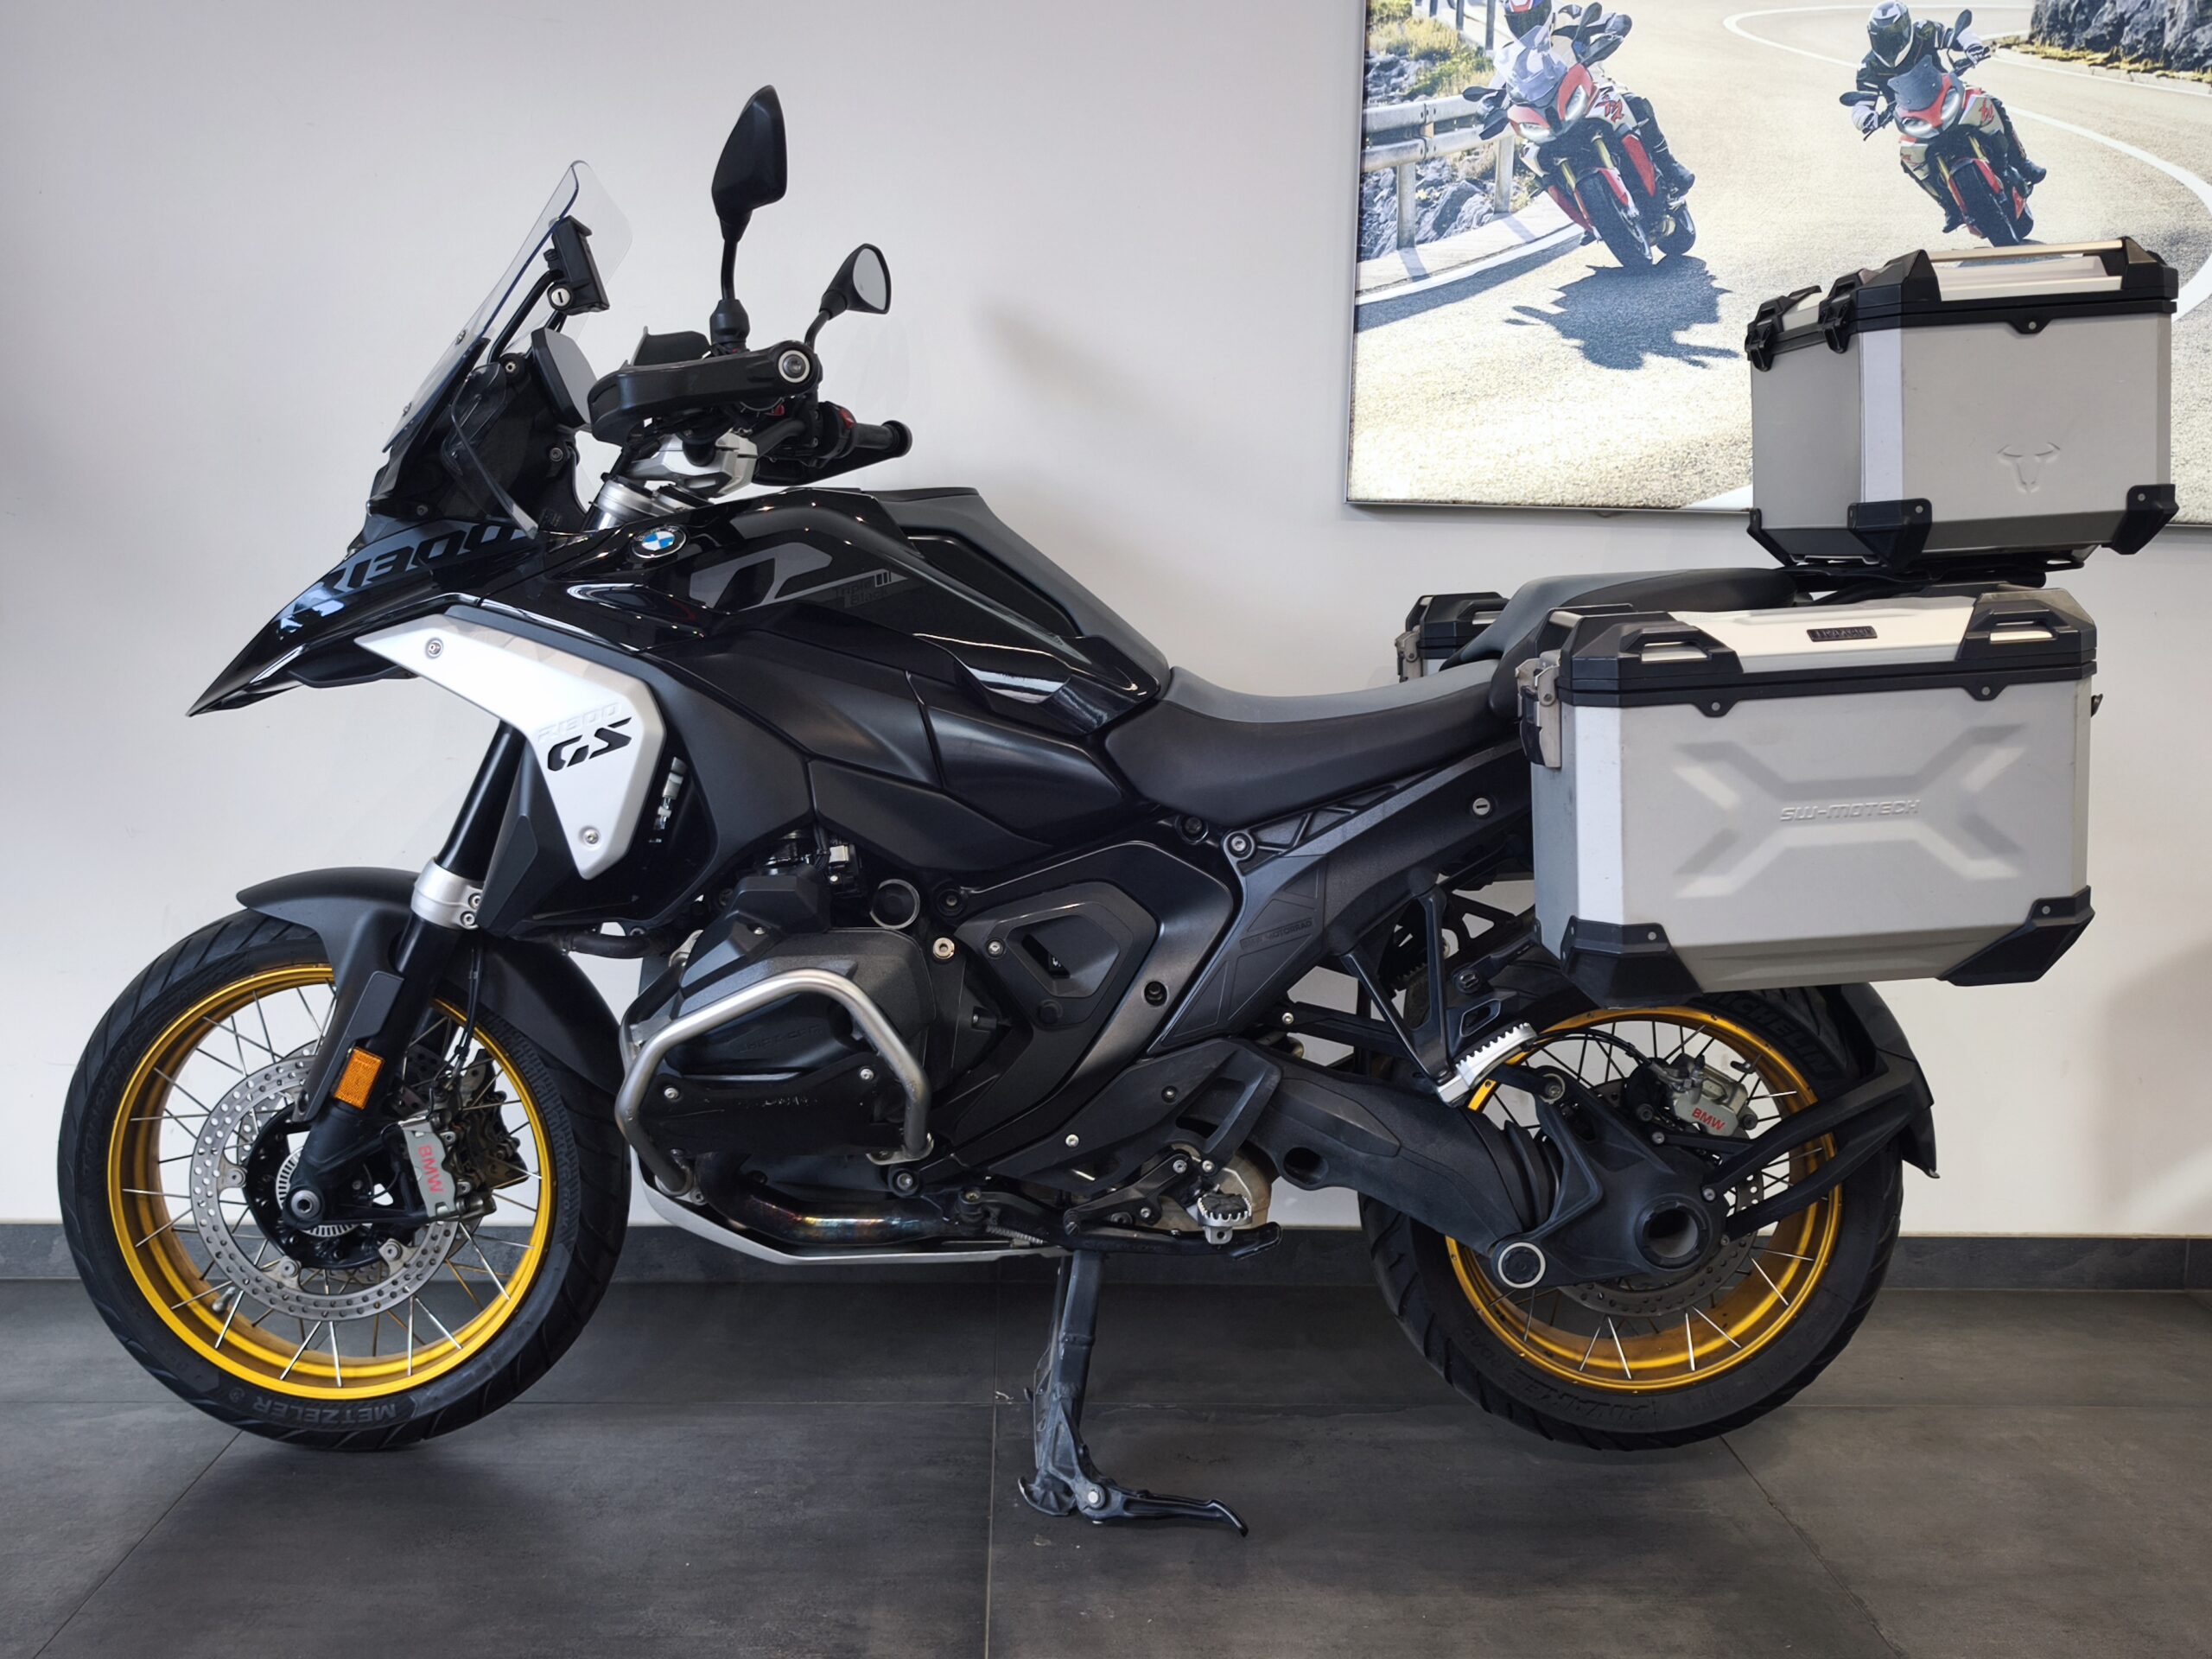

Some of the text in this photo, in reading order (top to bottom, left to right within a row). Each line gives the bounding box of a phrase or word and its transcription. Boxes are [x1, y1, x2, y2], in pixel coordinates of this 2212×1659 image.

[547, 716, 632, 772] GS
[1779, 799, 1922, 822] SW-MOTECH
[1691, 1107, 1726, 1132] BMW
[416, 1144, 445, 1193] BMW
[251, 1395, 396, 1425] METZELER
